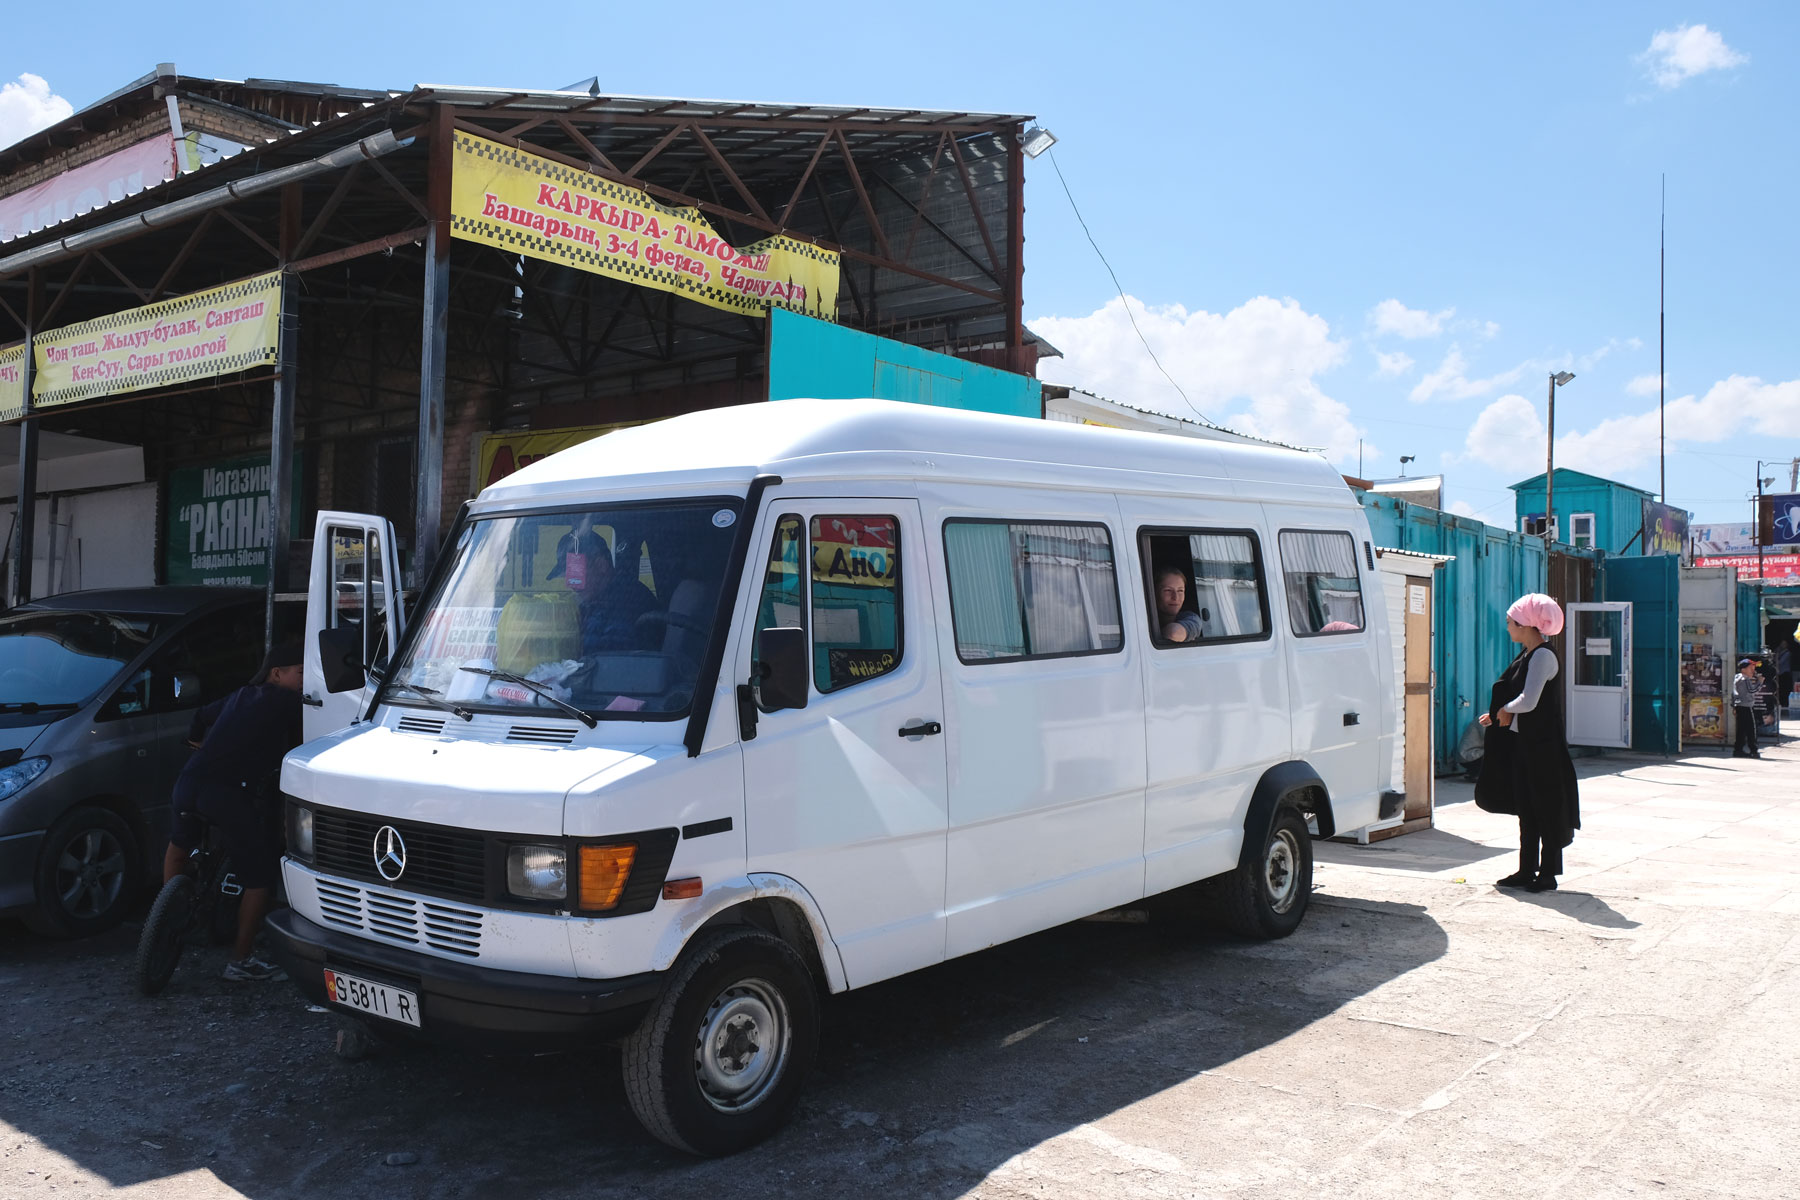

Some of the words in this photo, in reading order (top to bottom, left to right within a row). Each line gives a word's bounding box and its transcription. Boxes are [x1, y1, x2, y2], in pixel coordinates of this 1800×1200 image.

[482, 194, 600, 251] Башарын,
[606, 234, 639, 259] 3-4
[537, 184, 669, 238] КАРКЫРА-
[205, 302, 264, 329] Санташ
[127, 352, 164, 373] Сары
[168, 335, 227, 363] тологой
[203, 465, 270, 498] Магазин
[447, 629, 498, 643] САНТА
[335, 976, 348, 1002] S
[349, 980, 388, 1014] 5811
[397, 993, 413, 1021] R
